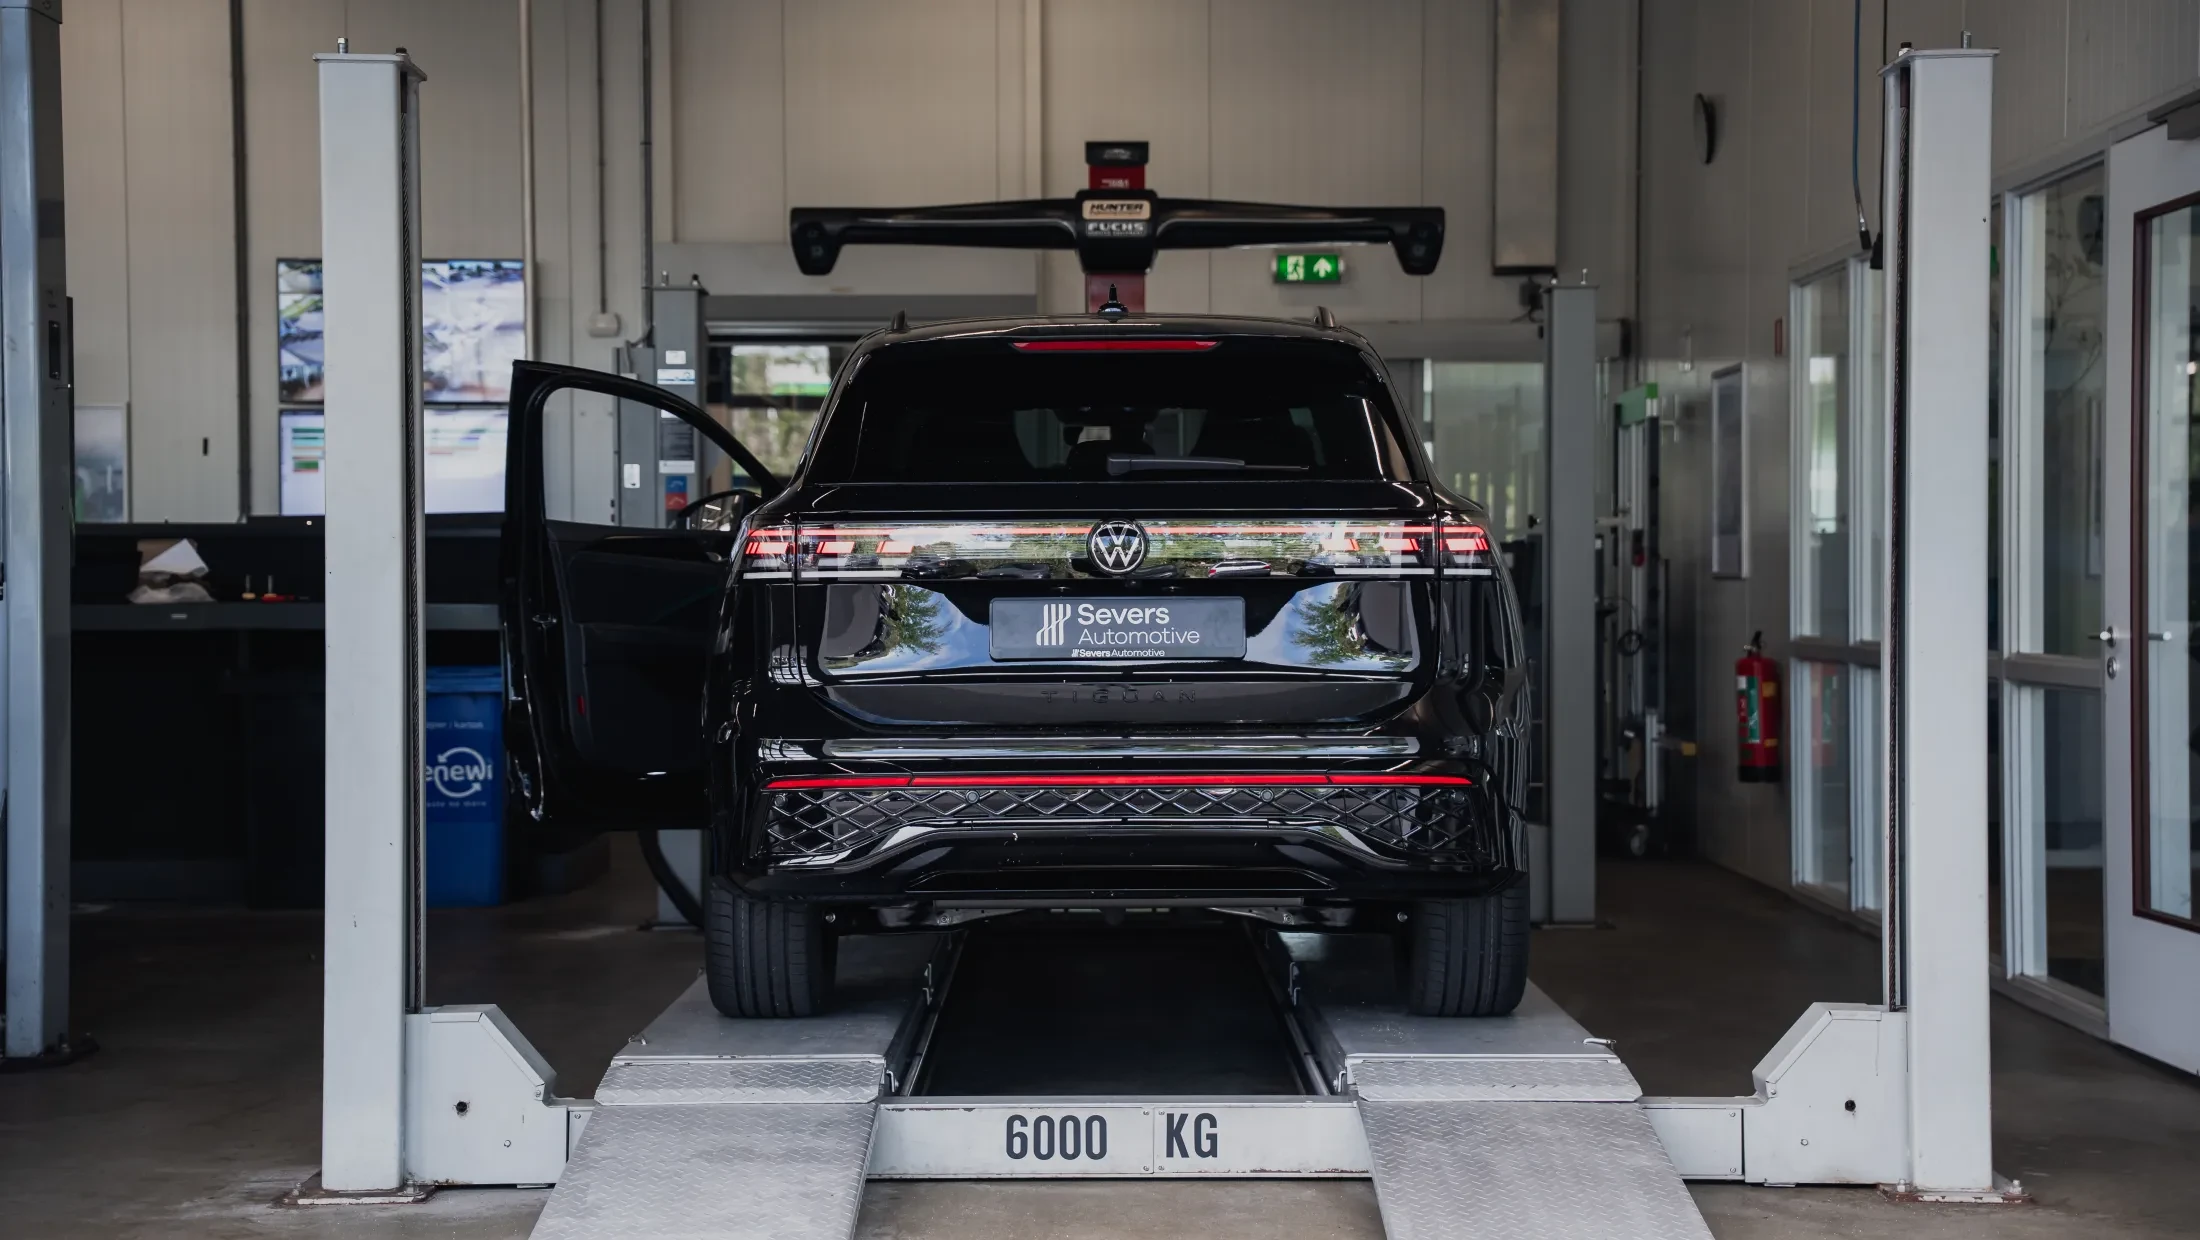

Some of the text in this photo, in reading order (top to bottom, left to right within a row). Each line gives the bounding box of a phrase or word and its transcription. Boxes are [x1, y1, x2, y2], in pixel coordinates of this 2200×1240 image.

[1090, 203, 1144, 212] HUNTER
[1087, 222, 1144, 232] FUCHS
[1077, 603, 1170, 625] Severs
[1077, 627, 1200, 645] Automotive
[1041, 689, 1196, 703] TIGUAN
[1005, 1112, 1218, 1160] 6000 KG
